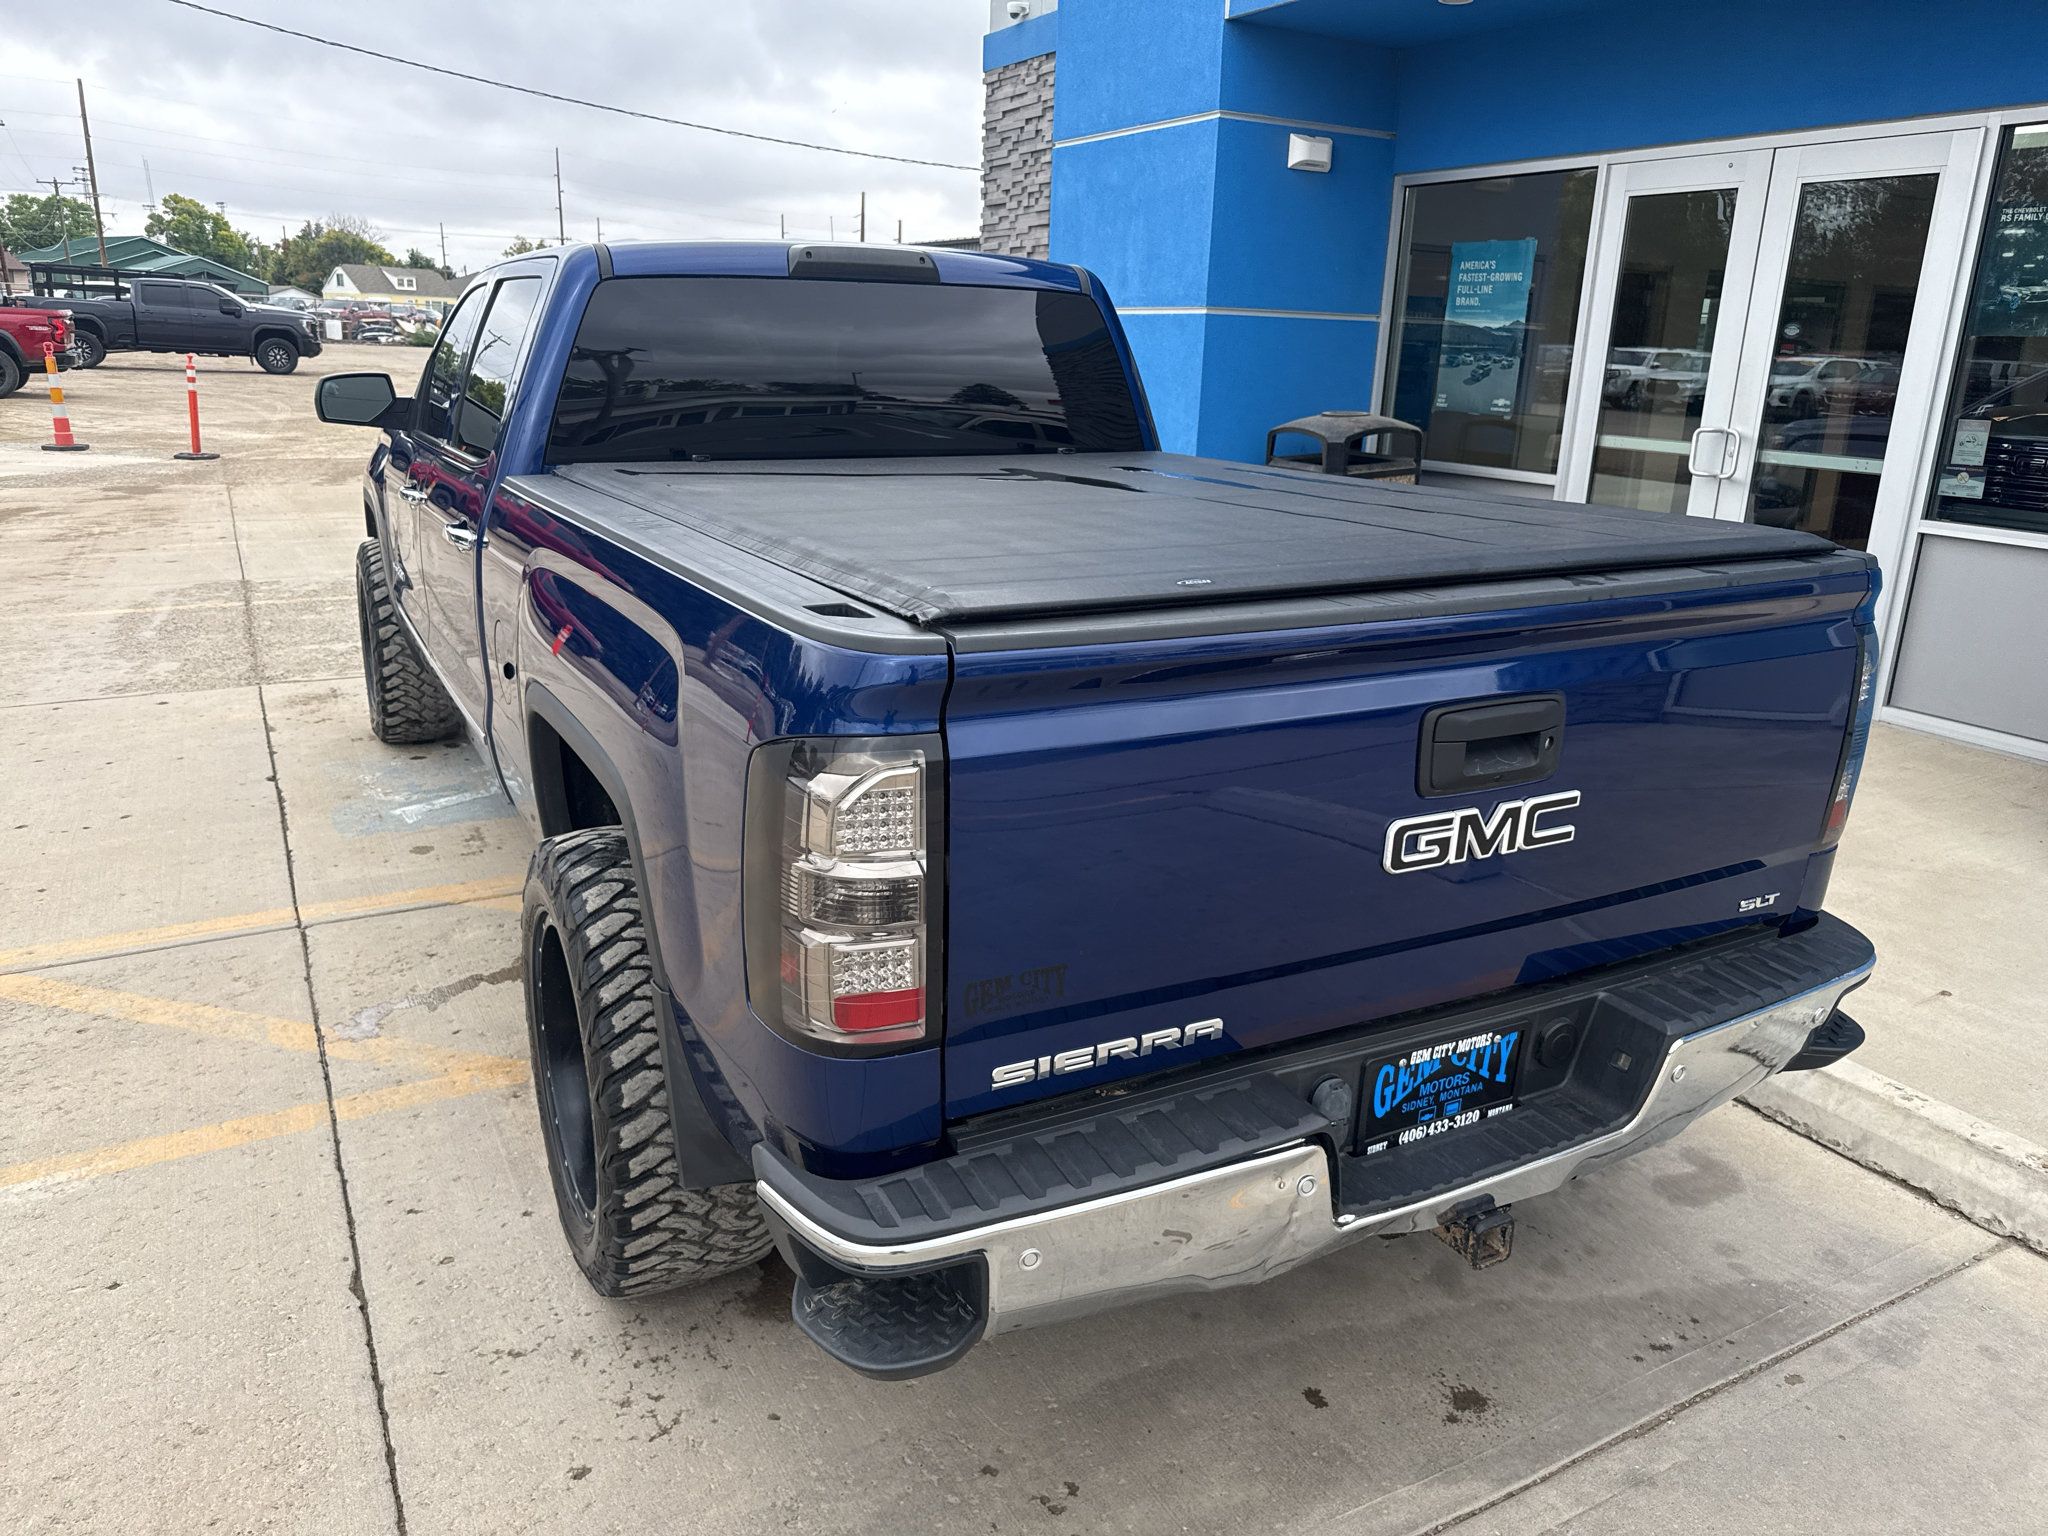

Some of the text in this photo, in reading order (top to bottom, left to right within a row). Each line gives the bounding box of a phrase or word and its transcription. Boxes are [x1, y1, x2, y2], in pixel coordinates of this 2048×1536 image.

[2000, 214, 2012, 223] RS
[2013, 212, 2044, 222] FAMILY
[2014, 206, 2047, 214] CHEVROLET
[1460, 260, 1497, 270] AMERICA'S
[1458, 272, 1523, 282] FASTEST-GROWING
[1457, 285, 1493, 294] FULL-LINE
[1455, 297, 1481, 306] BRAND.
[1382, 789, 1581, 875] GMC
[1738, 892, 1781, 913] SLT
[963, 962, 1070, 1017] GEM CITY
[991, 1017, 1224, 1091] SIERRA
[1410, 1032, 1493, 1066] GEM CITY MOTORS
[1373, 1031, 1518, 1119] GEM CITY
[1419, 1072, 1471, 1097] MOTORS
[1401, 1081, 1484, 1113] SIDNEY, MONTANA
